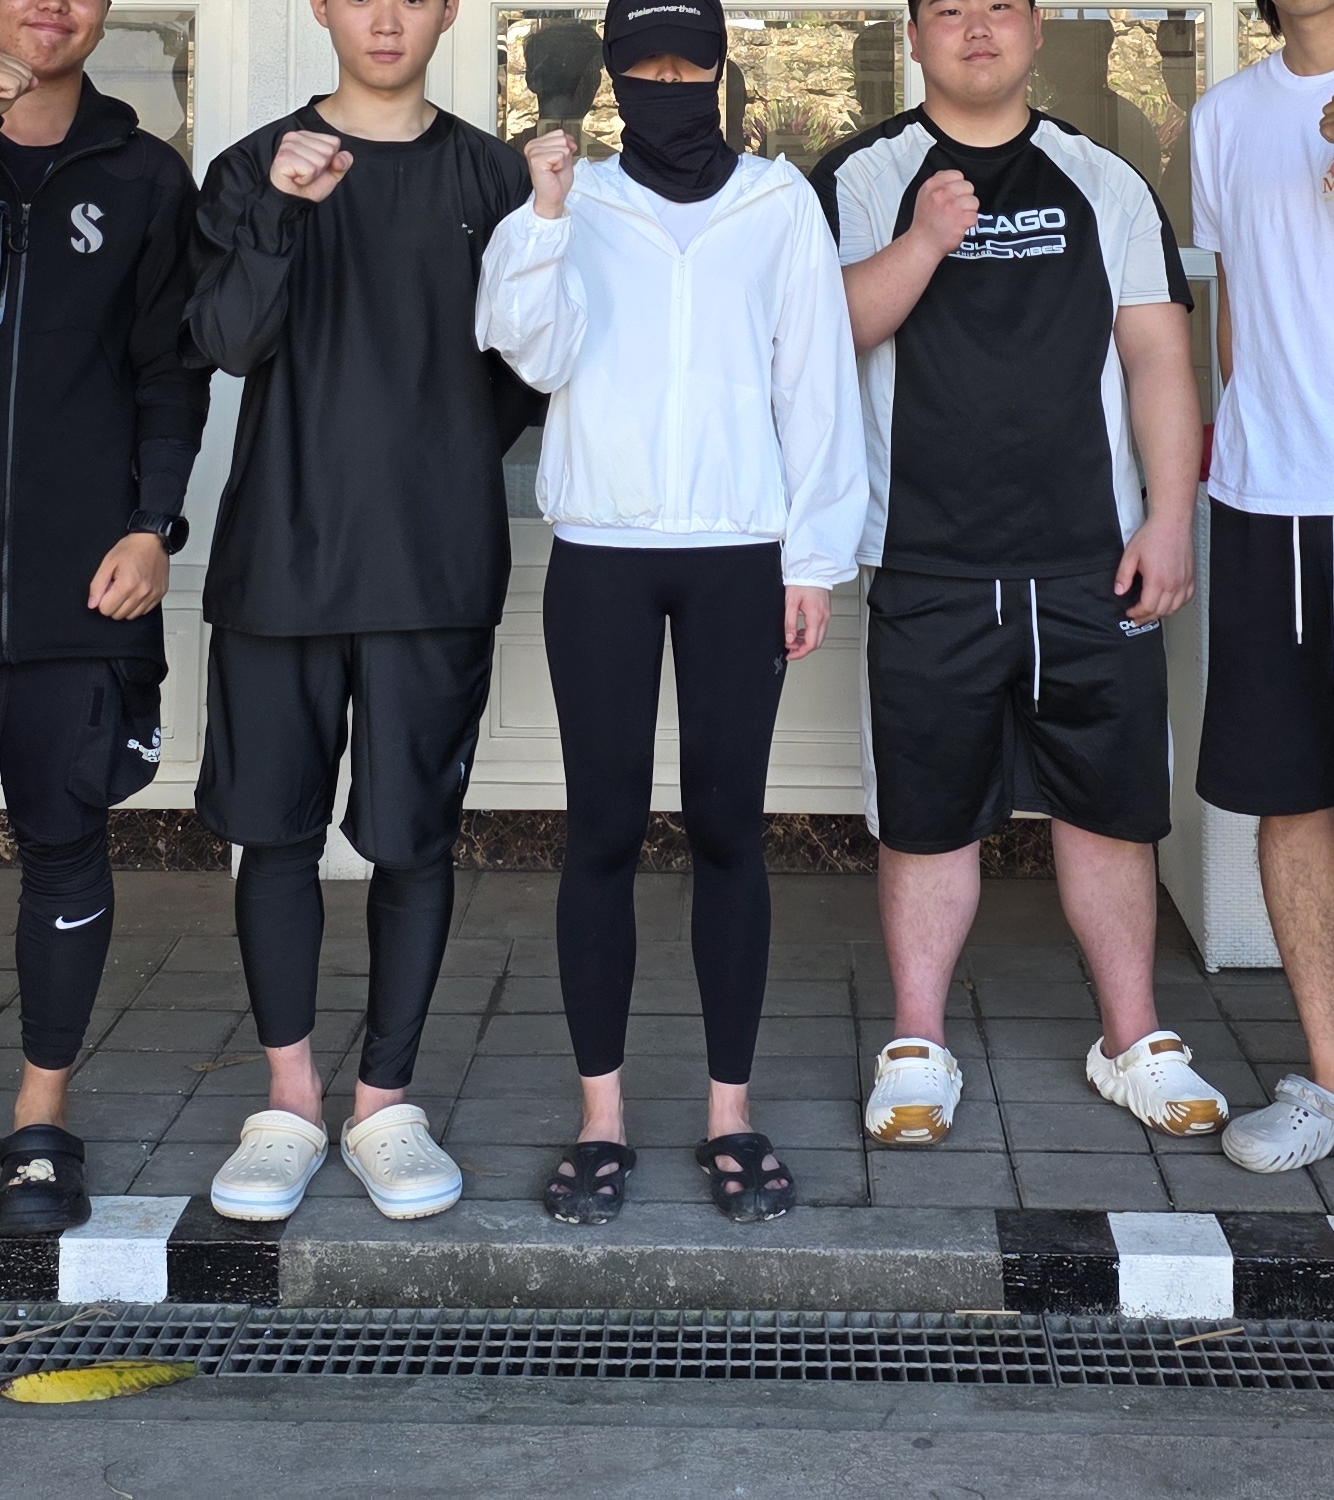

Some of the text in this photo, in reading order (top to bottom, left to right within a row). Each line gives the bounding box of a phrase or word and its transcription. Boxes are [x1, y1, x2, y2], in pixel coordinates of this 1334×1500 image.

[70, 203, 104, 253] S
[965, 208, 1066, 236] CAGO
[960, 242, 987, 251] OL
[1014, 246, 1065, 259] VIBES
